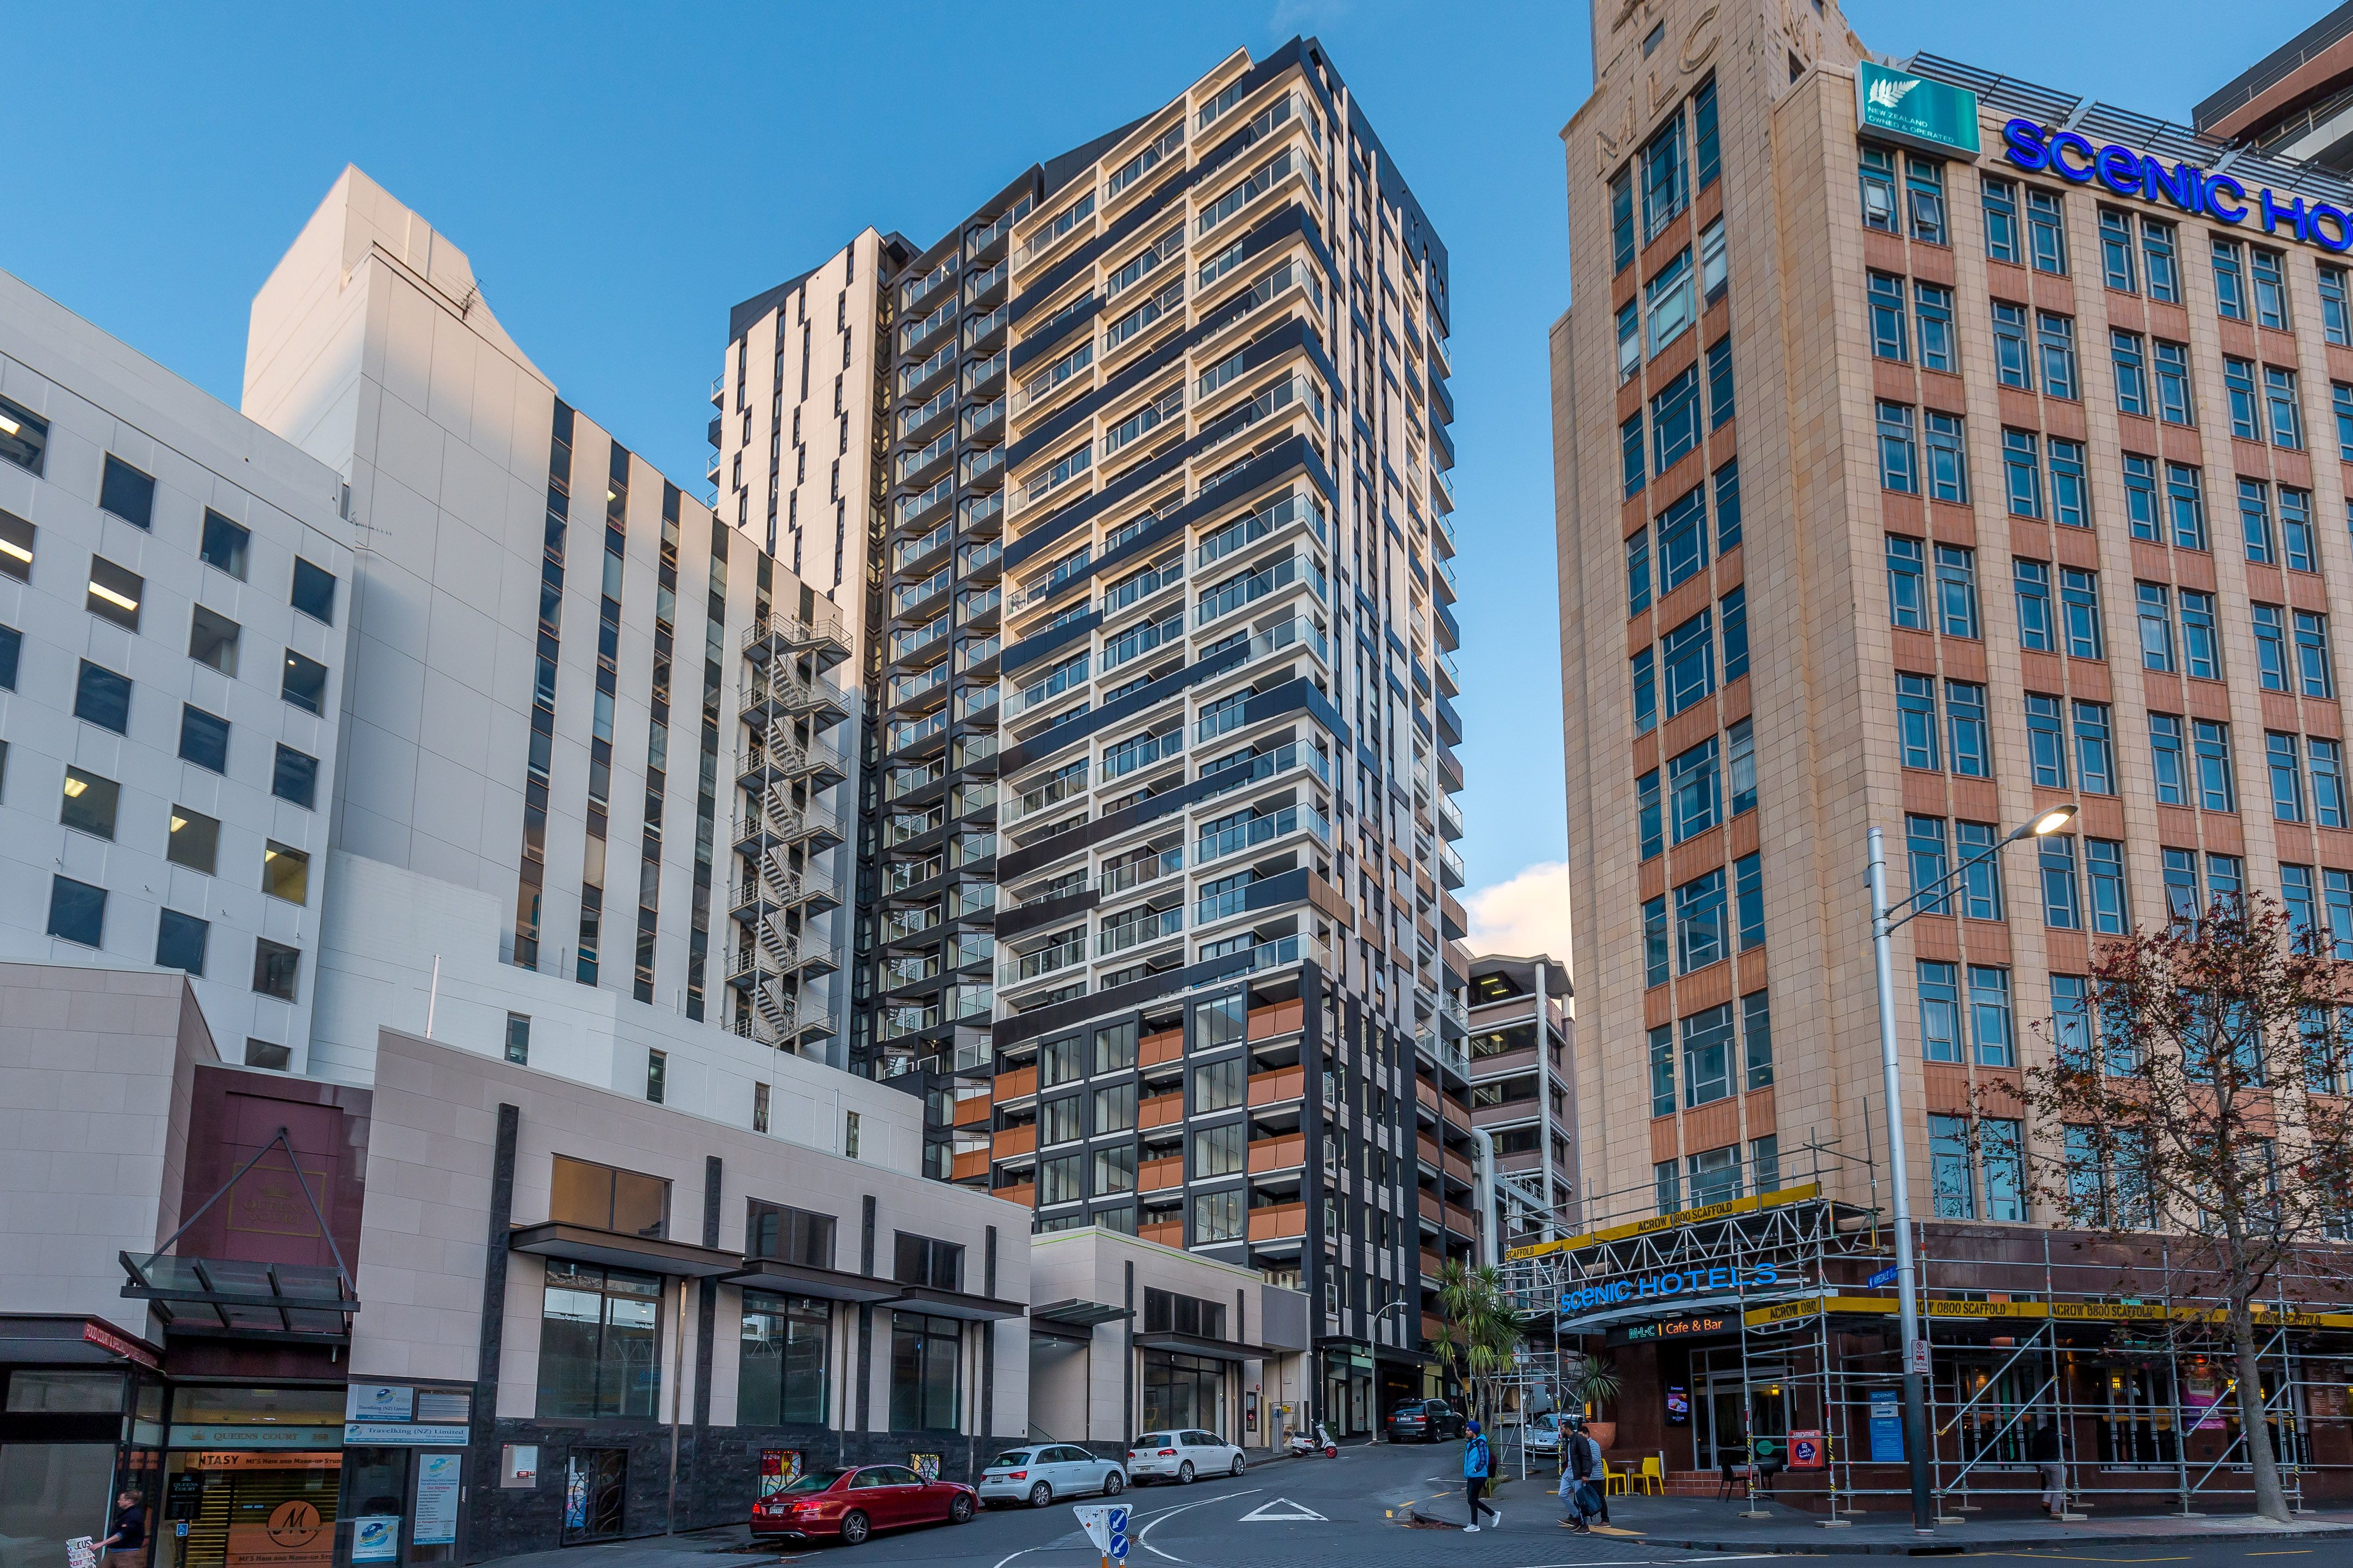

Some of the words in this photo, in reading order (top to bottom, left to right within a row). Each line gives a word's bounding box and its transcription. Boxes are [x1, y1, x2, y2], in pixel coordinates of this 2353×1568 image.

[1868, 106, 1886, 116] NEW
[1888, 112, 1928, 128] ZEALAND
[1868, 116, 1899, 128] OWNED
[1910, 127, 1954, 143] OPERATED
[2260, 188, 2353, 253] HO
[1637, 1216, 1667, 1233] ACROW
[1692, 1201, 1733, 1220] SCAFFOLD
[1505, 1246, 1535, 1260] SCAFFOLD
[1639, 1263, 1778, 1297] HOTELS
[1770, 1302, 1798, 1320] ACROW
[1937, 1302, 1961, 1313] 0800
[1963, 1302, 2006, 1315] SCAFFOLD
[2052, 1303, 2084, 1316] ACROW
[2087, 1304, 2110, 1317] 0800
[2112, 1305, 2153, 1318] SCAFFOLD
[1666, 1323, 1689, 1334] Cafe
[1692, 1320, 1701, 1331] &
[1704, 1319, 1723, 1331] Bar
[214, 1432, 258, 1441] QUEENS
